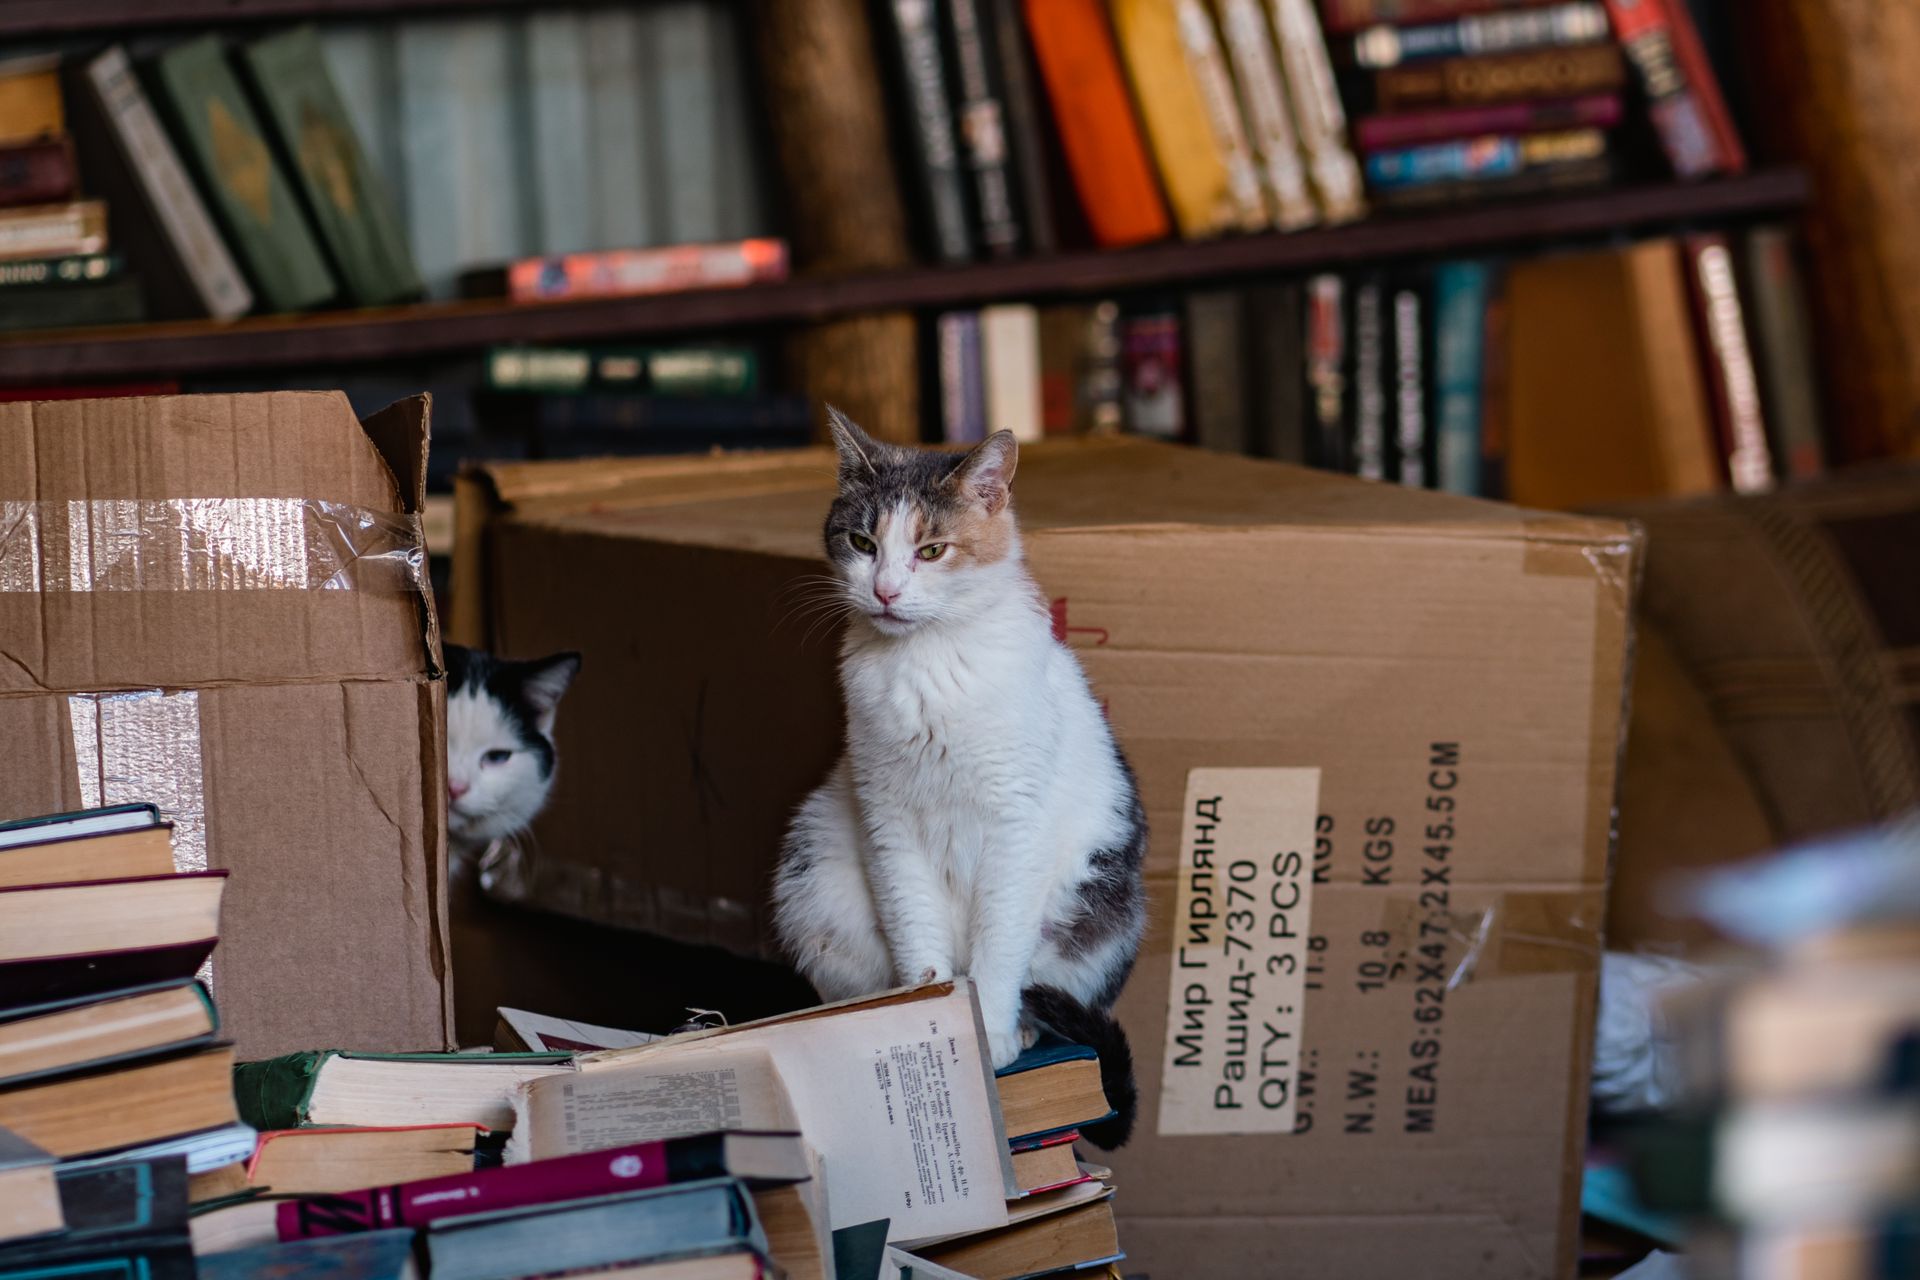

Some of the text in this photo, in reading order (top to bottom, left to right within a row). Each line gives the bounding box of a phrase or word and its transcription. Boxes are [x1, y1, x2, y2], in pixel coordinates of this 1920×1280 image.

[1173, 795, 1223, 1067] Мир Гирлянд
[1312, 814, 1334, 884] KGS
[1343, 816, 1396, 1134] N.W.: 10.8 KGS
[1214, 859, 1258, 1110] Рашид-7370
[1257, 851, 1303, 1110] QTY: 3 PCS
